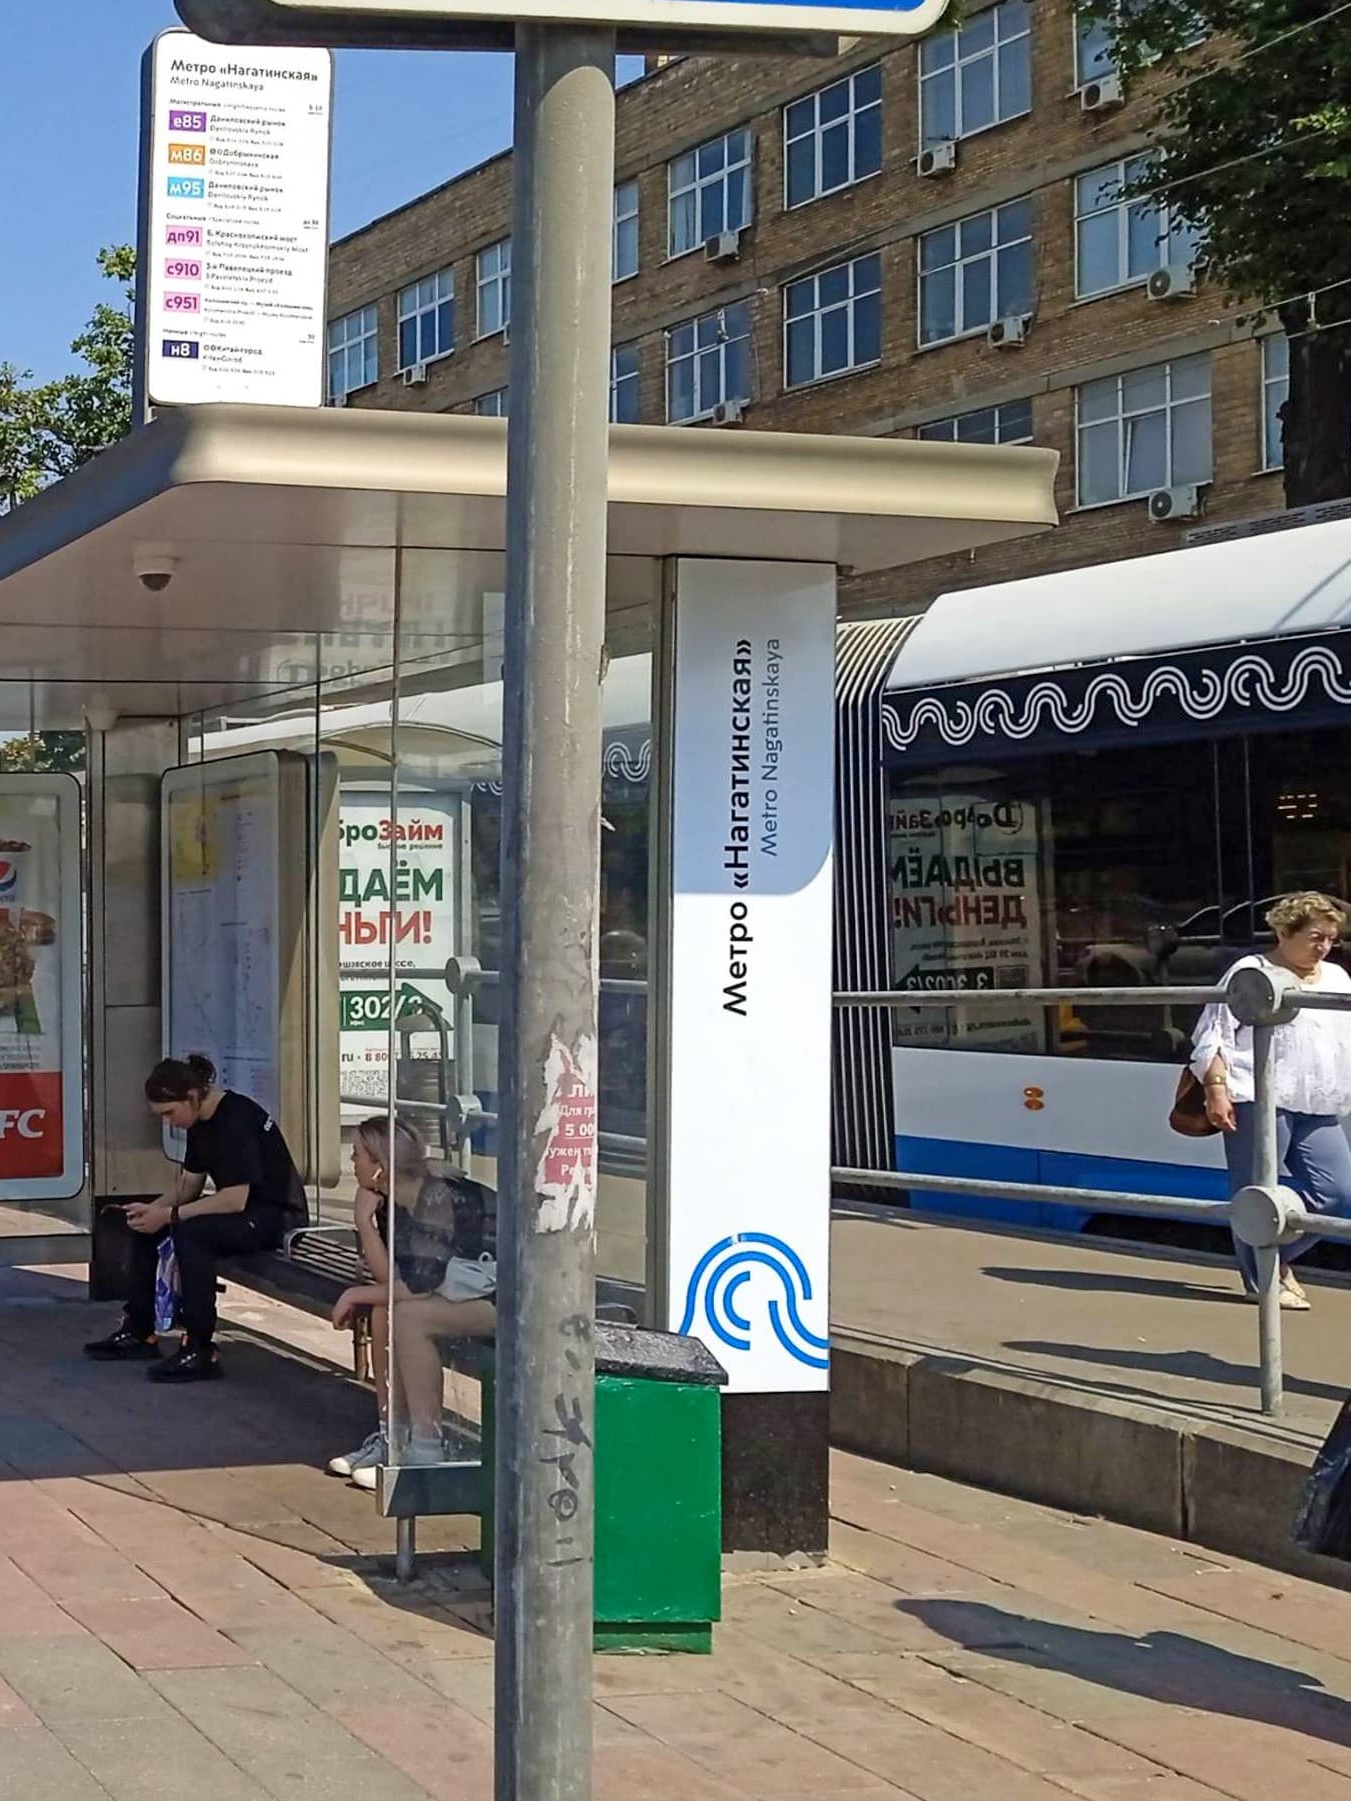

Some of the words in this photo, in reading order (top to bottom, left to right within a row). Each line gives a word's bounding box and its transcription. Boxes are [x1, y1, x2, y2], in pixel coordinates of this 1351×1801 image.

[170, 59, 217, 75] Метро
[220, 63, 318, 81] «Нагатинская»
[170, 76, 200, 86] Metro
[201, 79, 264, 91] Nagatinskaya
[169, 181, 202, 195] м95
[167, 230, 200, 244] дп91
[167, 262, 200, 276] с910
[166, 296, 198, 310] с951
[171, 342, 191, 357] н8
[761, 638, 783, 781] Nagatinskaya
[724, 638, 752, 890] «Нагатинская»
[761, 790, 778, 857] Metro
[722, 901, 753, 1017] Метро
[561, 1104, 582, 1118] Для
[565, 1124, 575, 1137] 5
